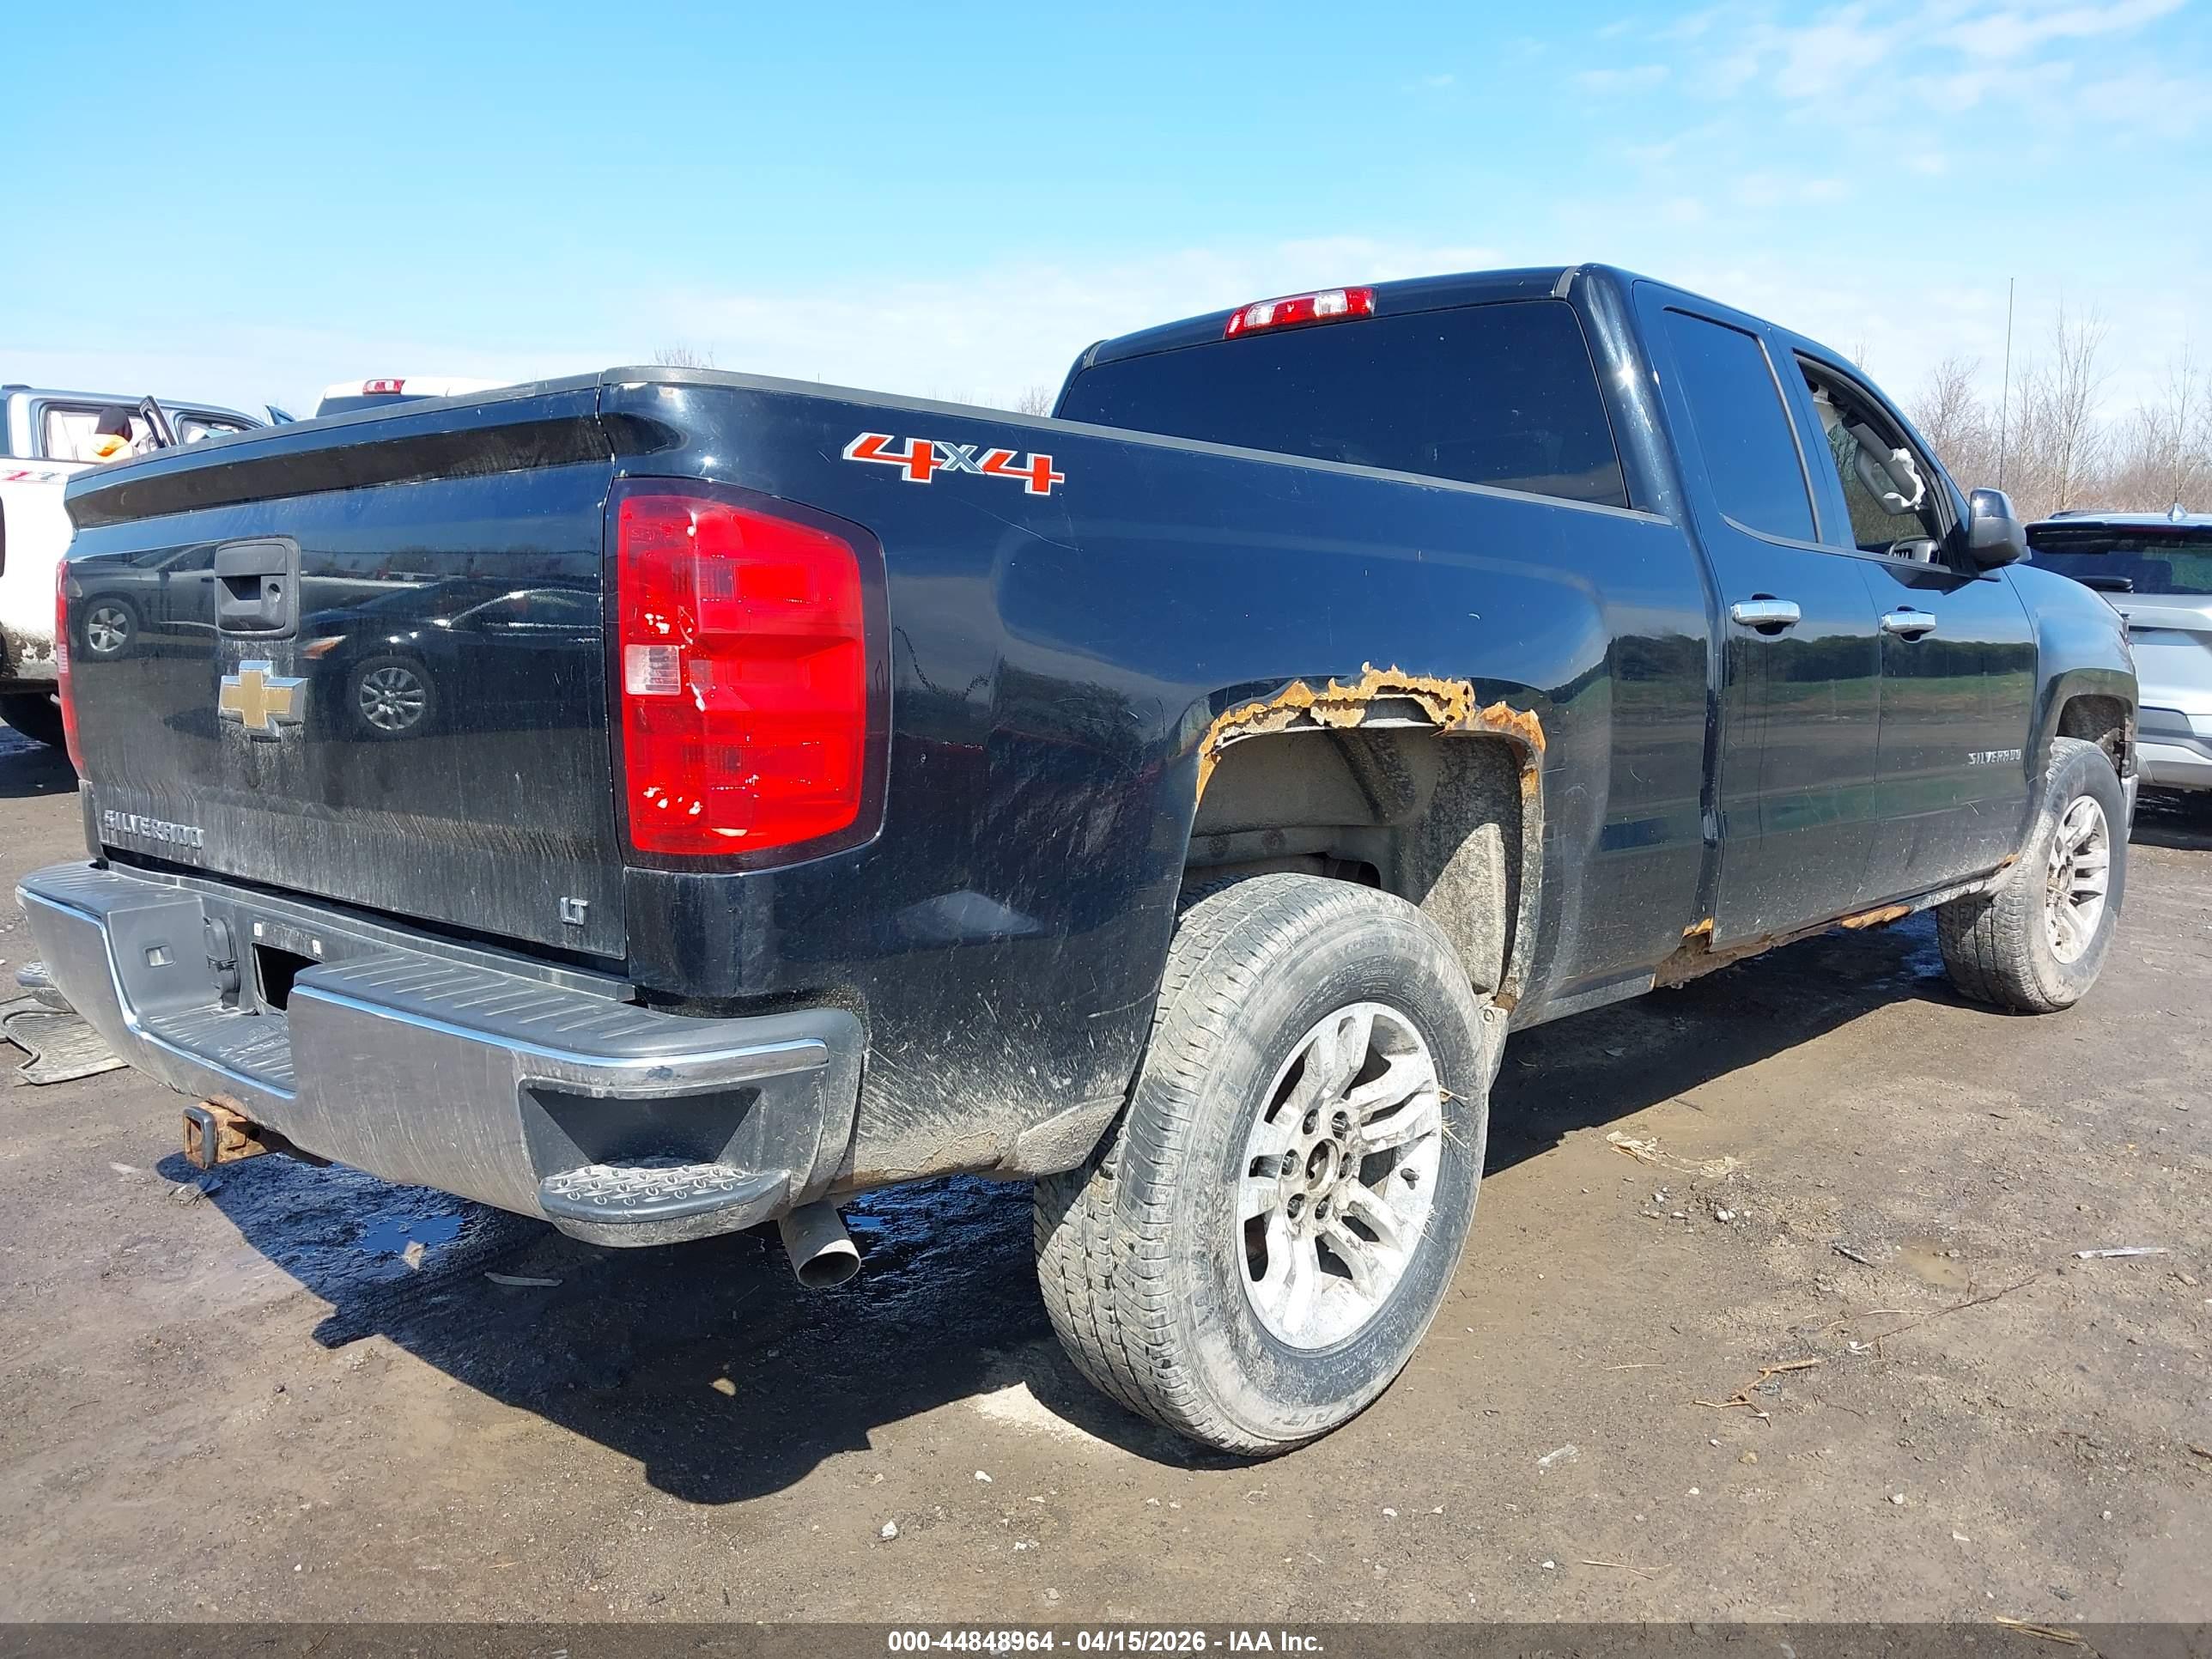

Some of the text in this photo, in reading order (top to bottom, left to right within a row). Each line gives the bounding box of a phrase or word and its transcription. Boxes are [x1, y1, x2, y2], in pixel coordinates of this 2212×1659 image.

[1967, 749, 2022, 765] SILVERADO
[105, 809, 204, 849] SILVERADO
[560, 896, 590, 926] LT
